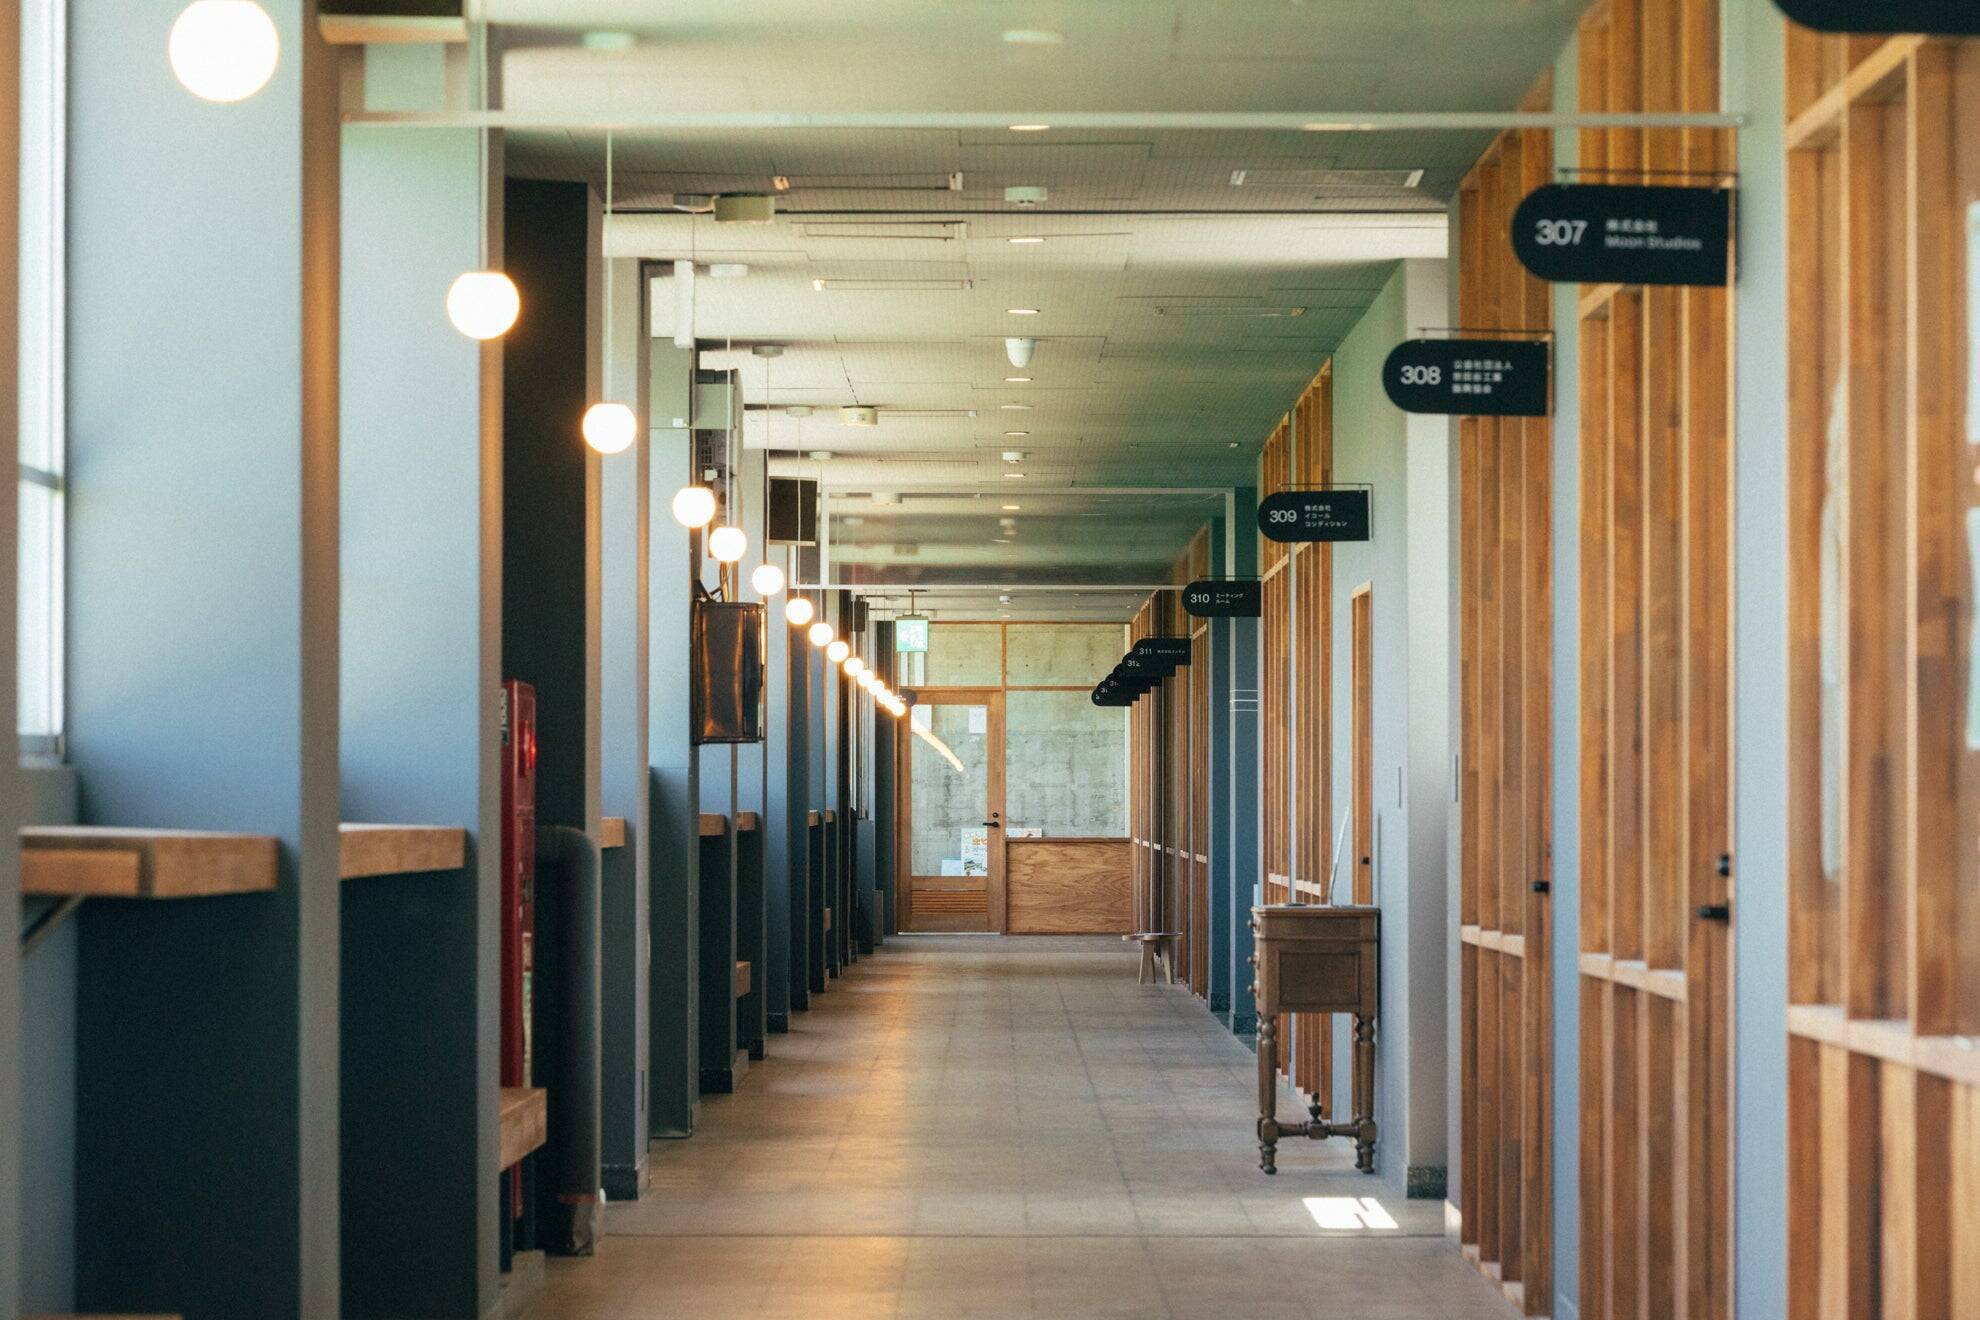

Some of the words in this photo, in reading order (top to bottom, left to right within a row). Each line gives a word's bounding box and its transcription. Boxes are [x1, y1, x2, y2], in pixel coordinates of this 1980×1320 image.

[1535, 219, 1588, 246] 307
[1400, 365, 1441, 385] 308
[1269, 510, 1297, 523] 309
[1190, 593, 1210, 603] 310
